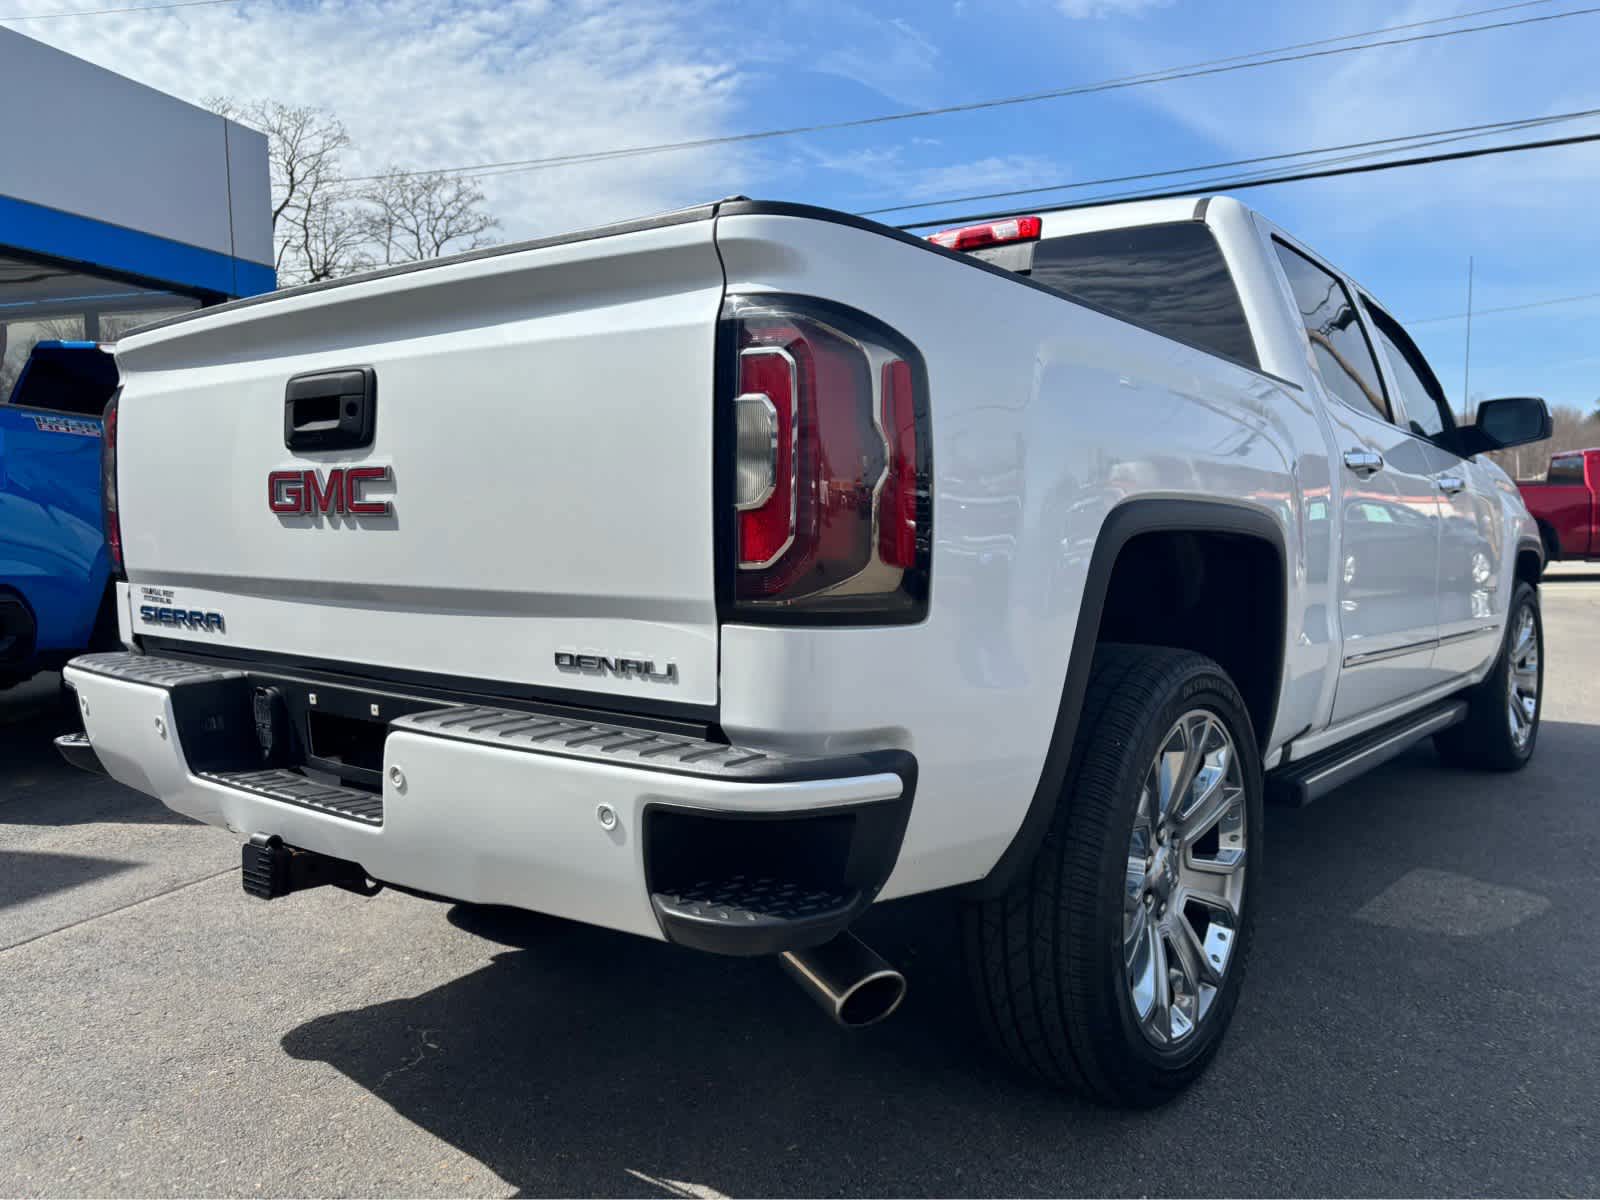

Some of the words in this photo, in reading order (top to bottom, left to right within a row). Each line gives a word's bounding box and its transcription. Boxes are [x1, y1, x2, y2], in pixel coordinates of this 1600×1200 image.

[268, 465, 393, 516] GMC
[140, 605, 225, 632] SIERRA
[555, 652, 678, 682] DENALI
